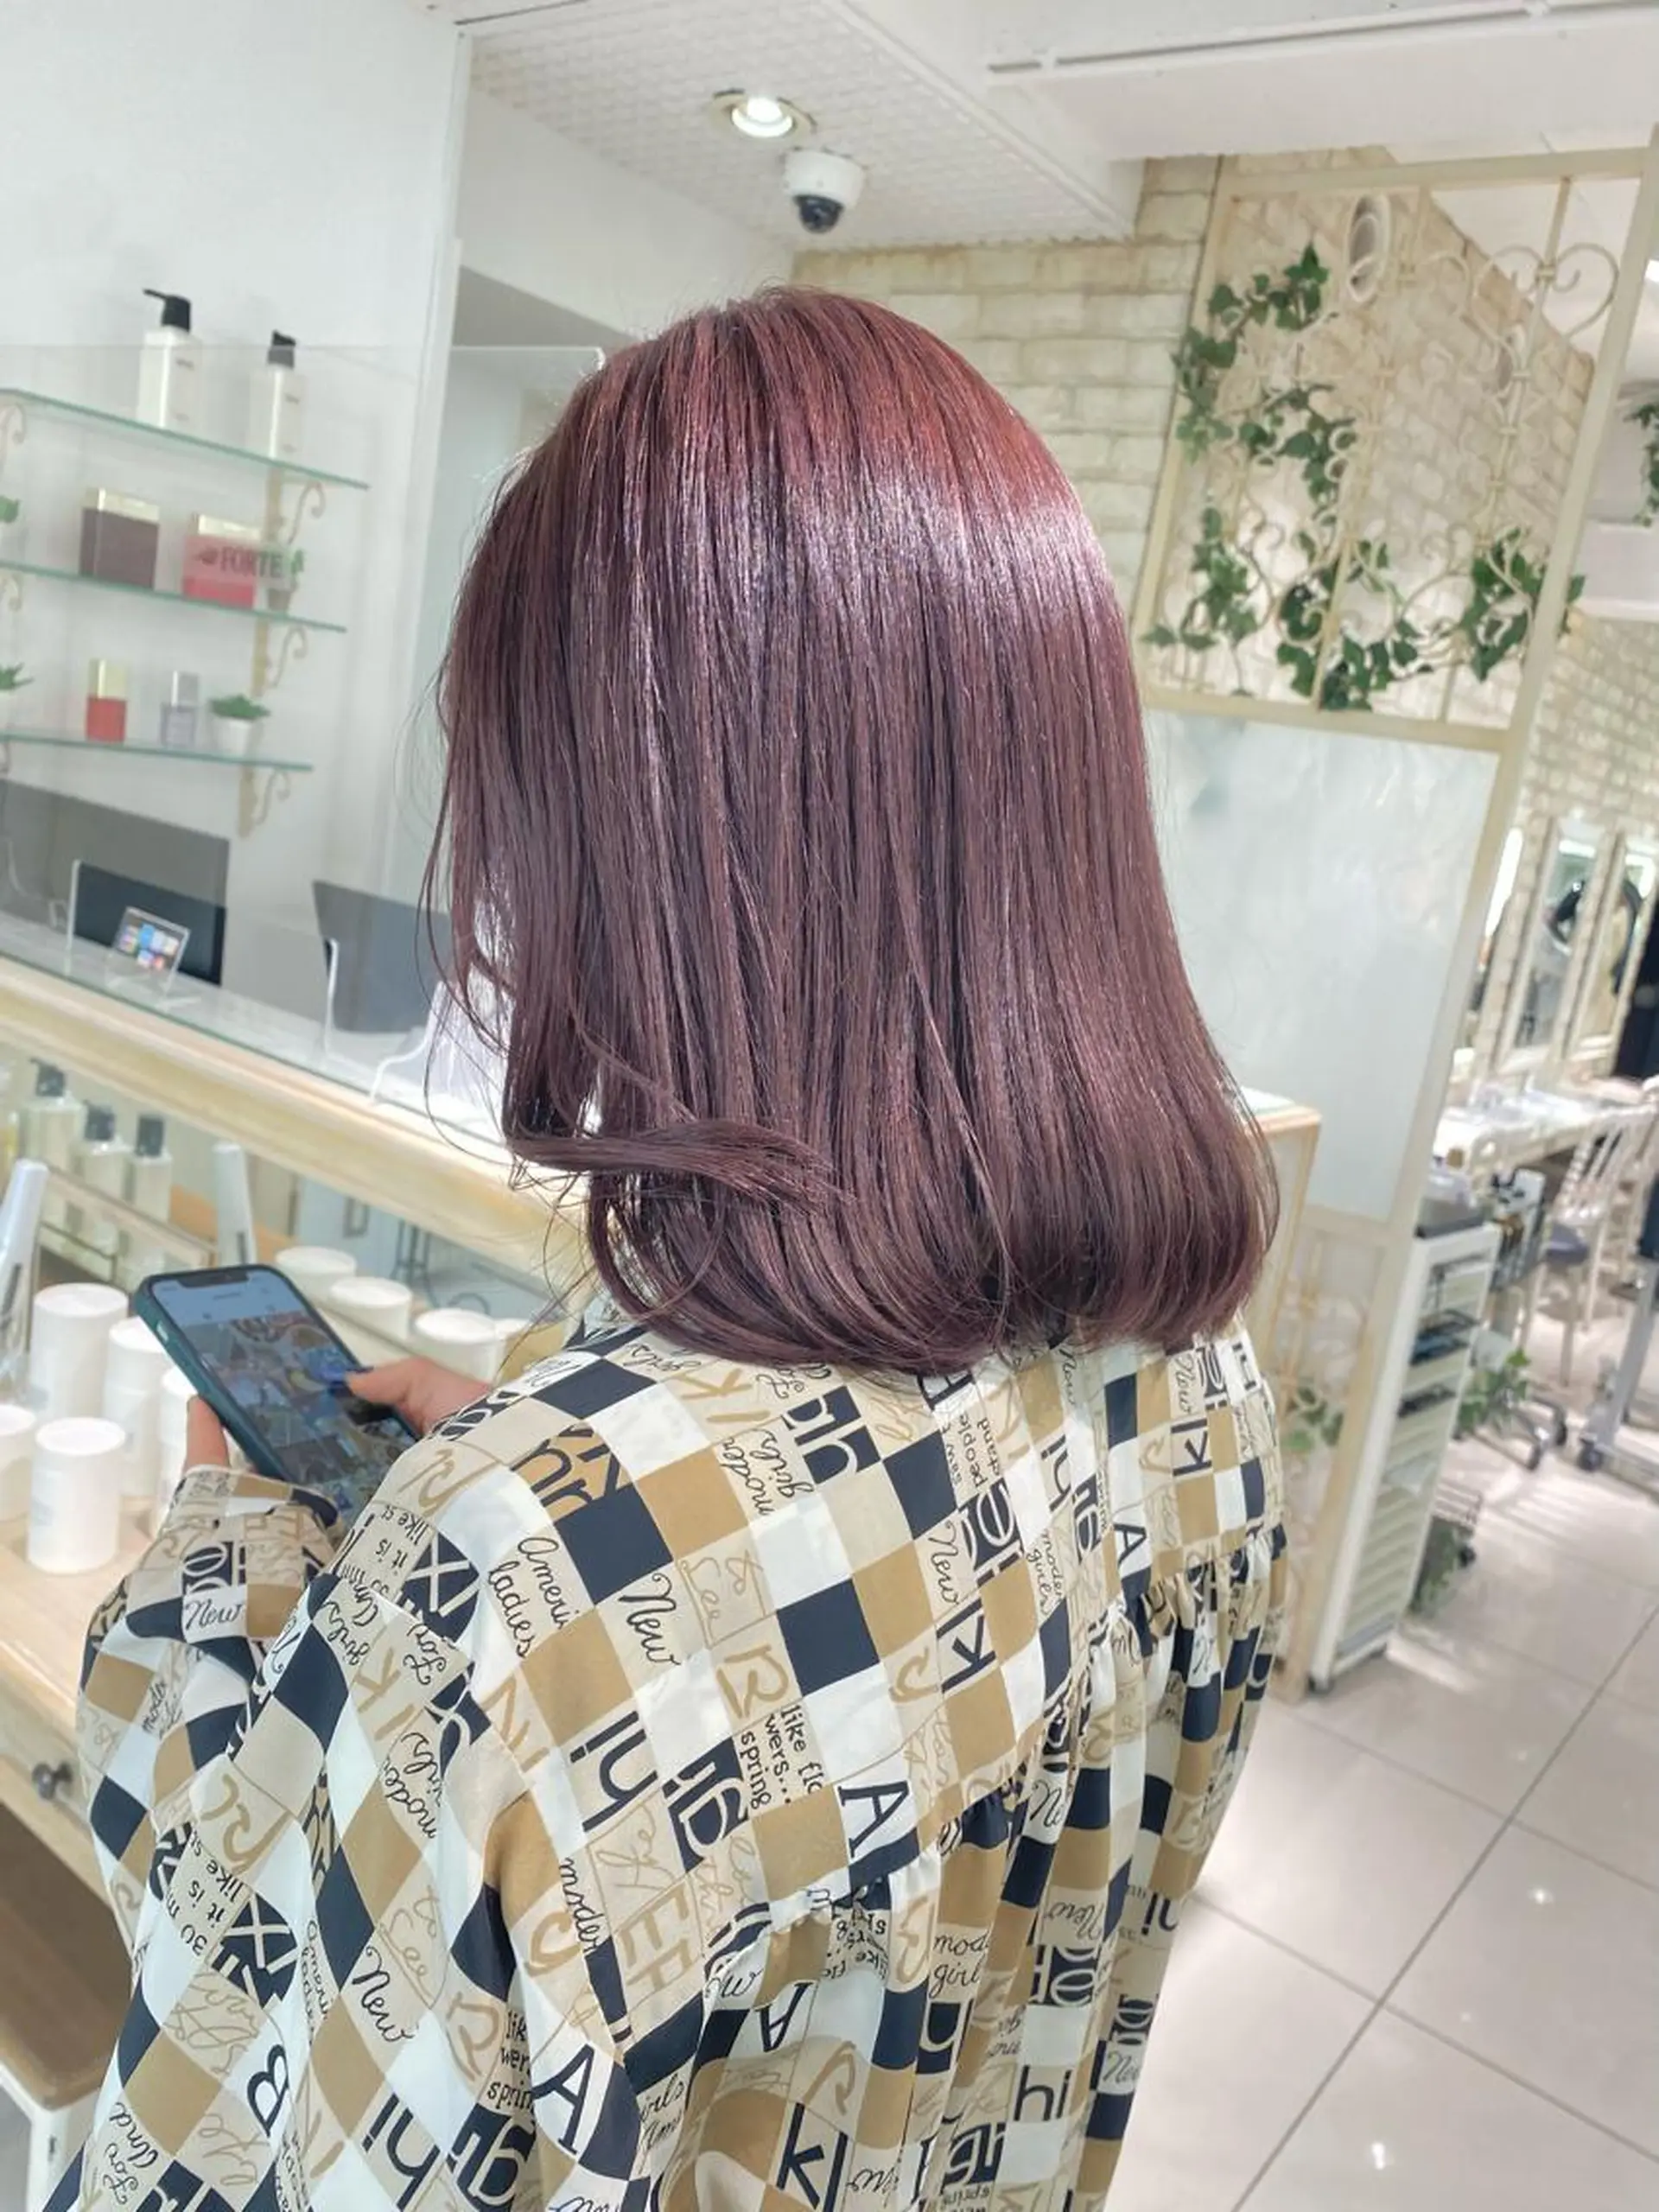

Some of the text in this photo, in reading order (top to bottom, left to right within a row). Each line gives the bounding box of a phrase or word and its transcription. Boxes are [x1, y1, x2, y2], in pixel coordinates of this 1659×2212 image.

[221, 546, 283, 578] FORTE
[397, 1514, 429, 1547] like
[374, 1538, 408, 1576] it is
[929, 1518, 962, 1605] New
[184, 1599, 243, 1630] New
[620, 1573, 681, 1666] New
[779, 1704, 807, 1752] like
[741, 1731, 772, 1809] spring
[188, 1880, 226, 1928] it is
[206, 1862, 243, 1903] like
[351, 1946, 416, 2043] New
[1014, 2064, 1071, 2121] hi
